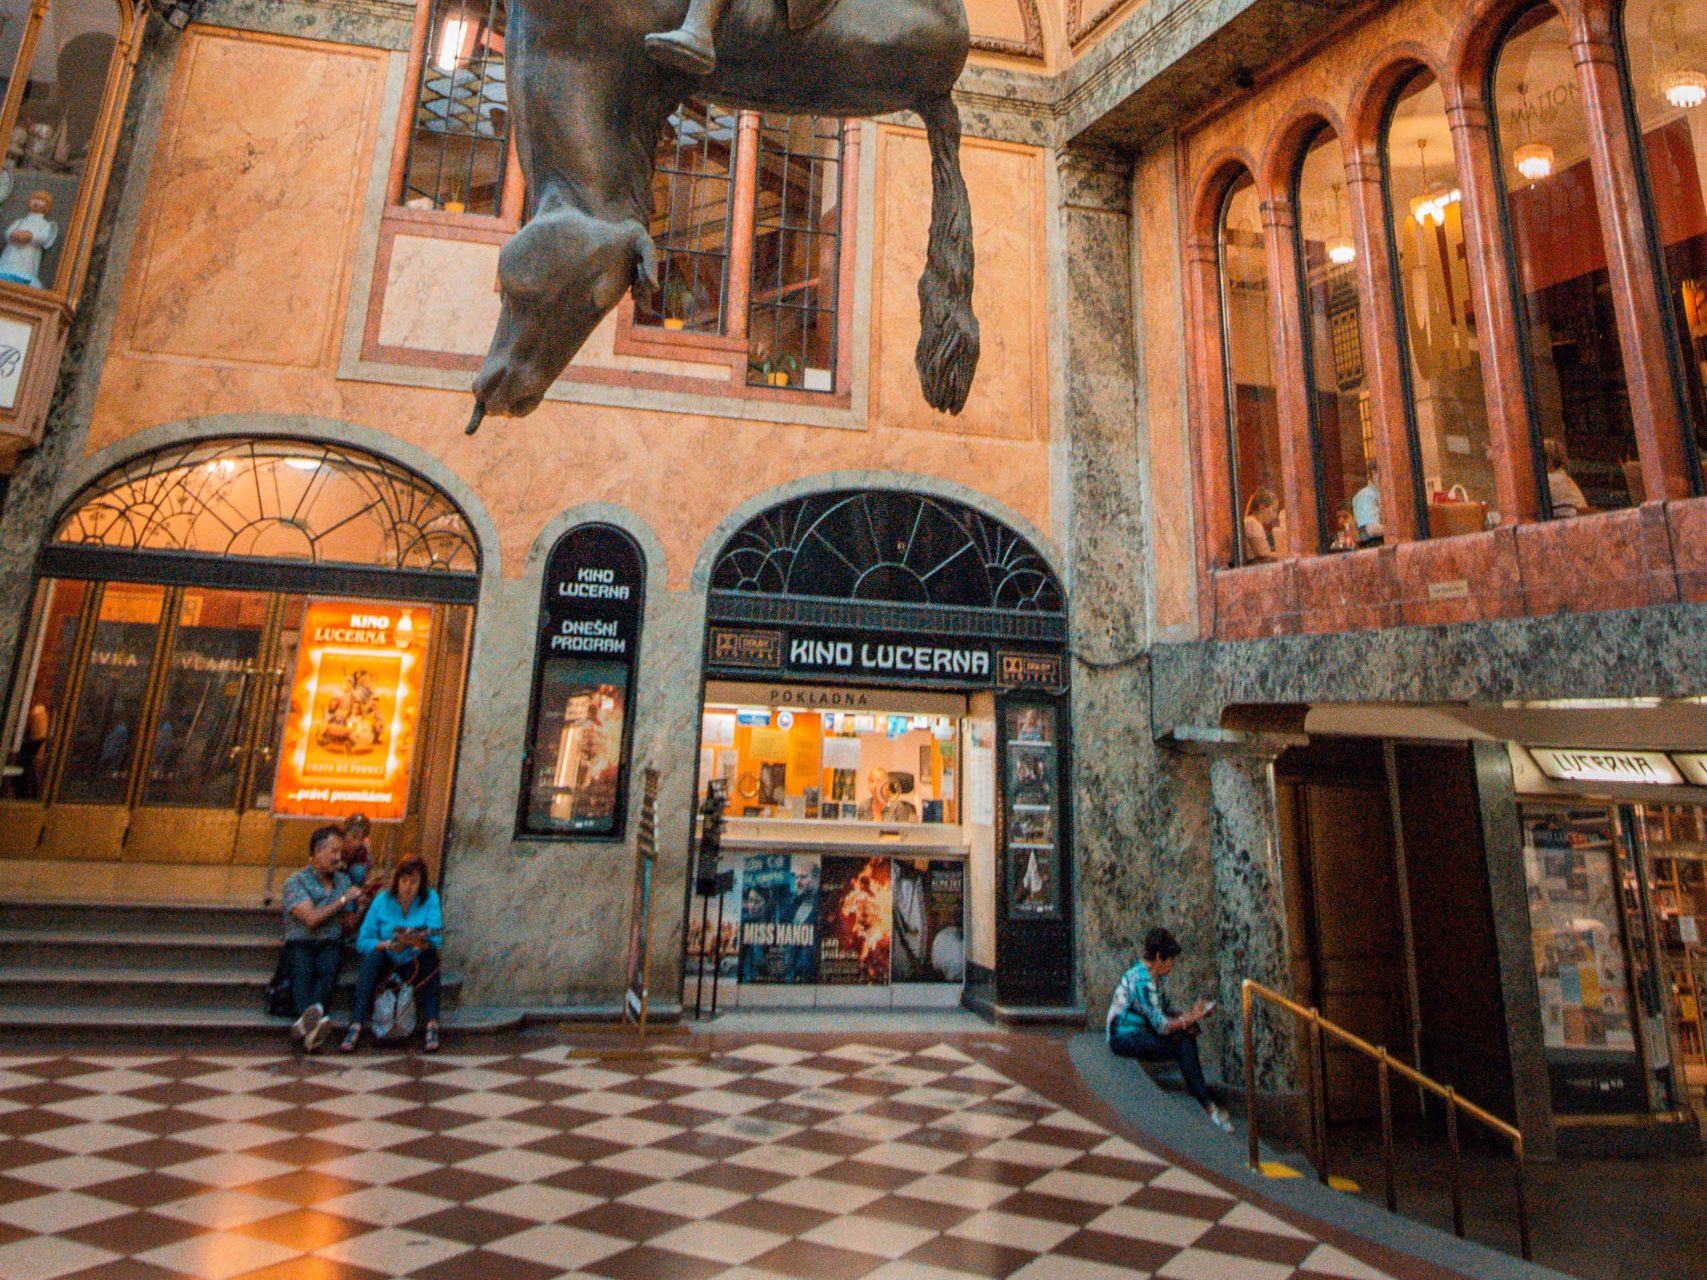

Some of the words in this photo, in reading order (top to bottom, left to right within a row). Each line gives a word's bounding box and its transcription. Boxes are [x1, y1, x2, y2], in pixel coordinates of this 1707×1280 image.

[1508, 82, 1580, 125] MATTON
[578, 567, 614, 583] KINO
[559, 582, 630, 599] LUCERNA
[350, 614, 390, 630] KINO
[562, 620, 618, 636] DNEŠNÍ
[314, 628, 386, 644] LUCERNA
[551, 635, 626, 653] PROGRAM
[790, 639, 853, 666] KINO
[861, 644, 990, 675] LUCERNA
[770, 690, 868, 705] POKLADNA
[1552, 753, 1656, 777] LUCERNA
[743, 923, 775, 945] MISS
[776, 924, 814, 946] HANOI
